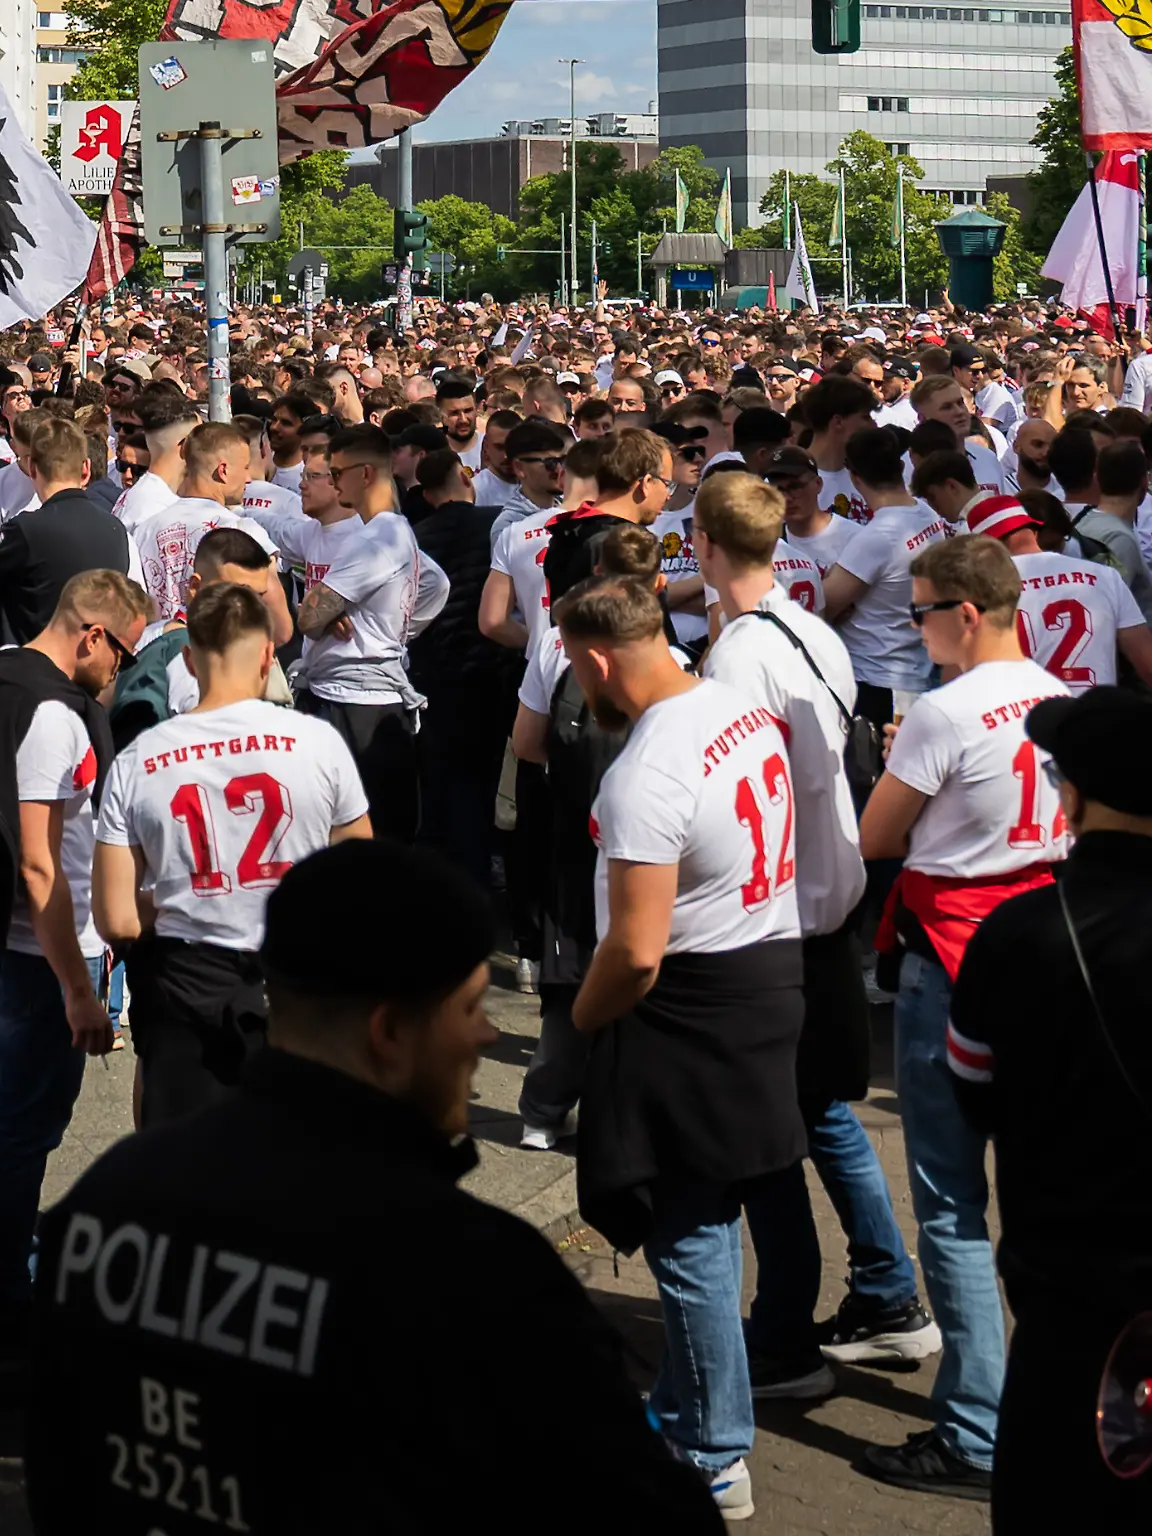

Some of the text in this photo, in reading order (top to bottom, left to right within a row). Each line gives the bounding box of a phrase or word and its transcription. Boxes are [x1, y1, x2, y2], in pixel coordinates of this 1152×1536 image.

[688, 272, 697, 282] U
[143, 734, 296, 775] STUTTGART
[169, 772, 295, 898] 12
[55, 1212, 330, 1377] POLIZEI
[140, 1376, 202, 1451] BE
[105, 1433, 251, 1533] 25211
